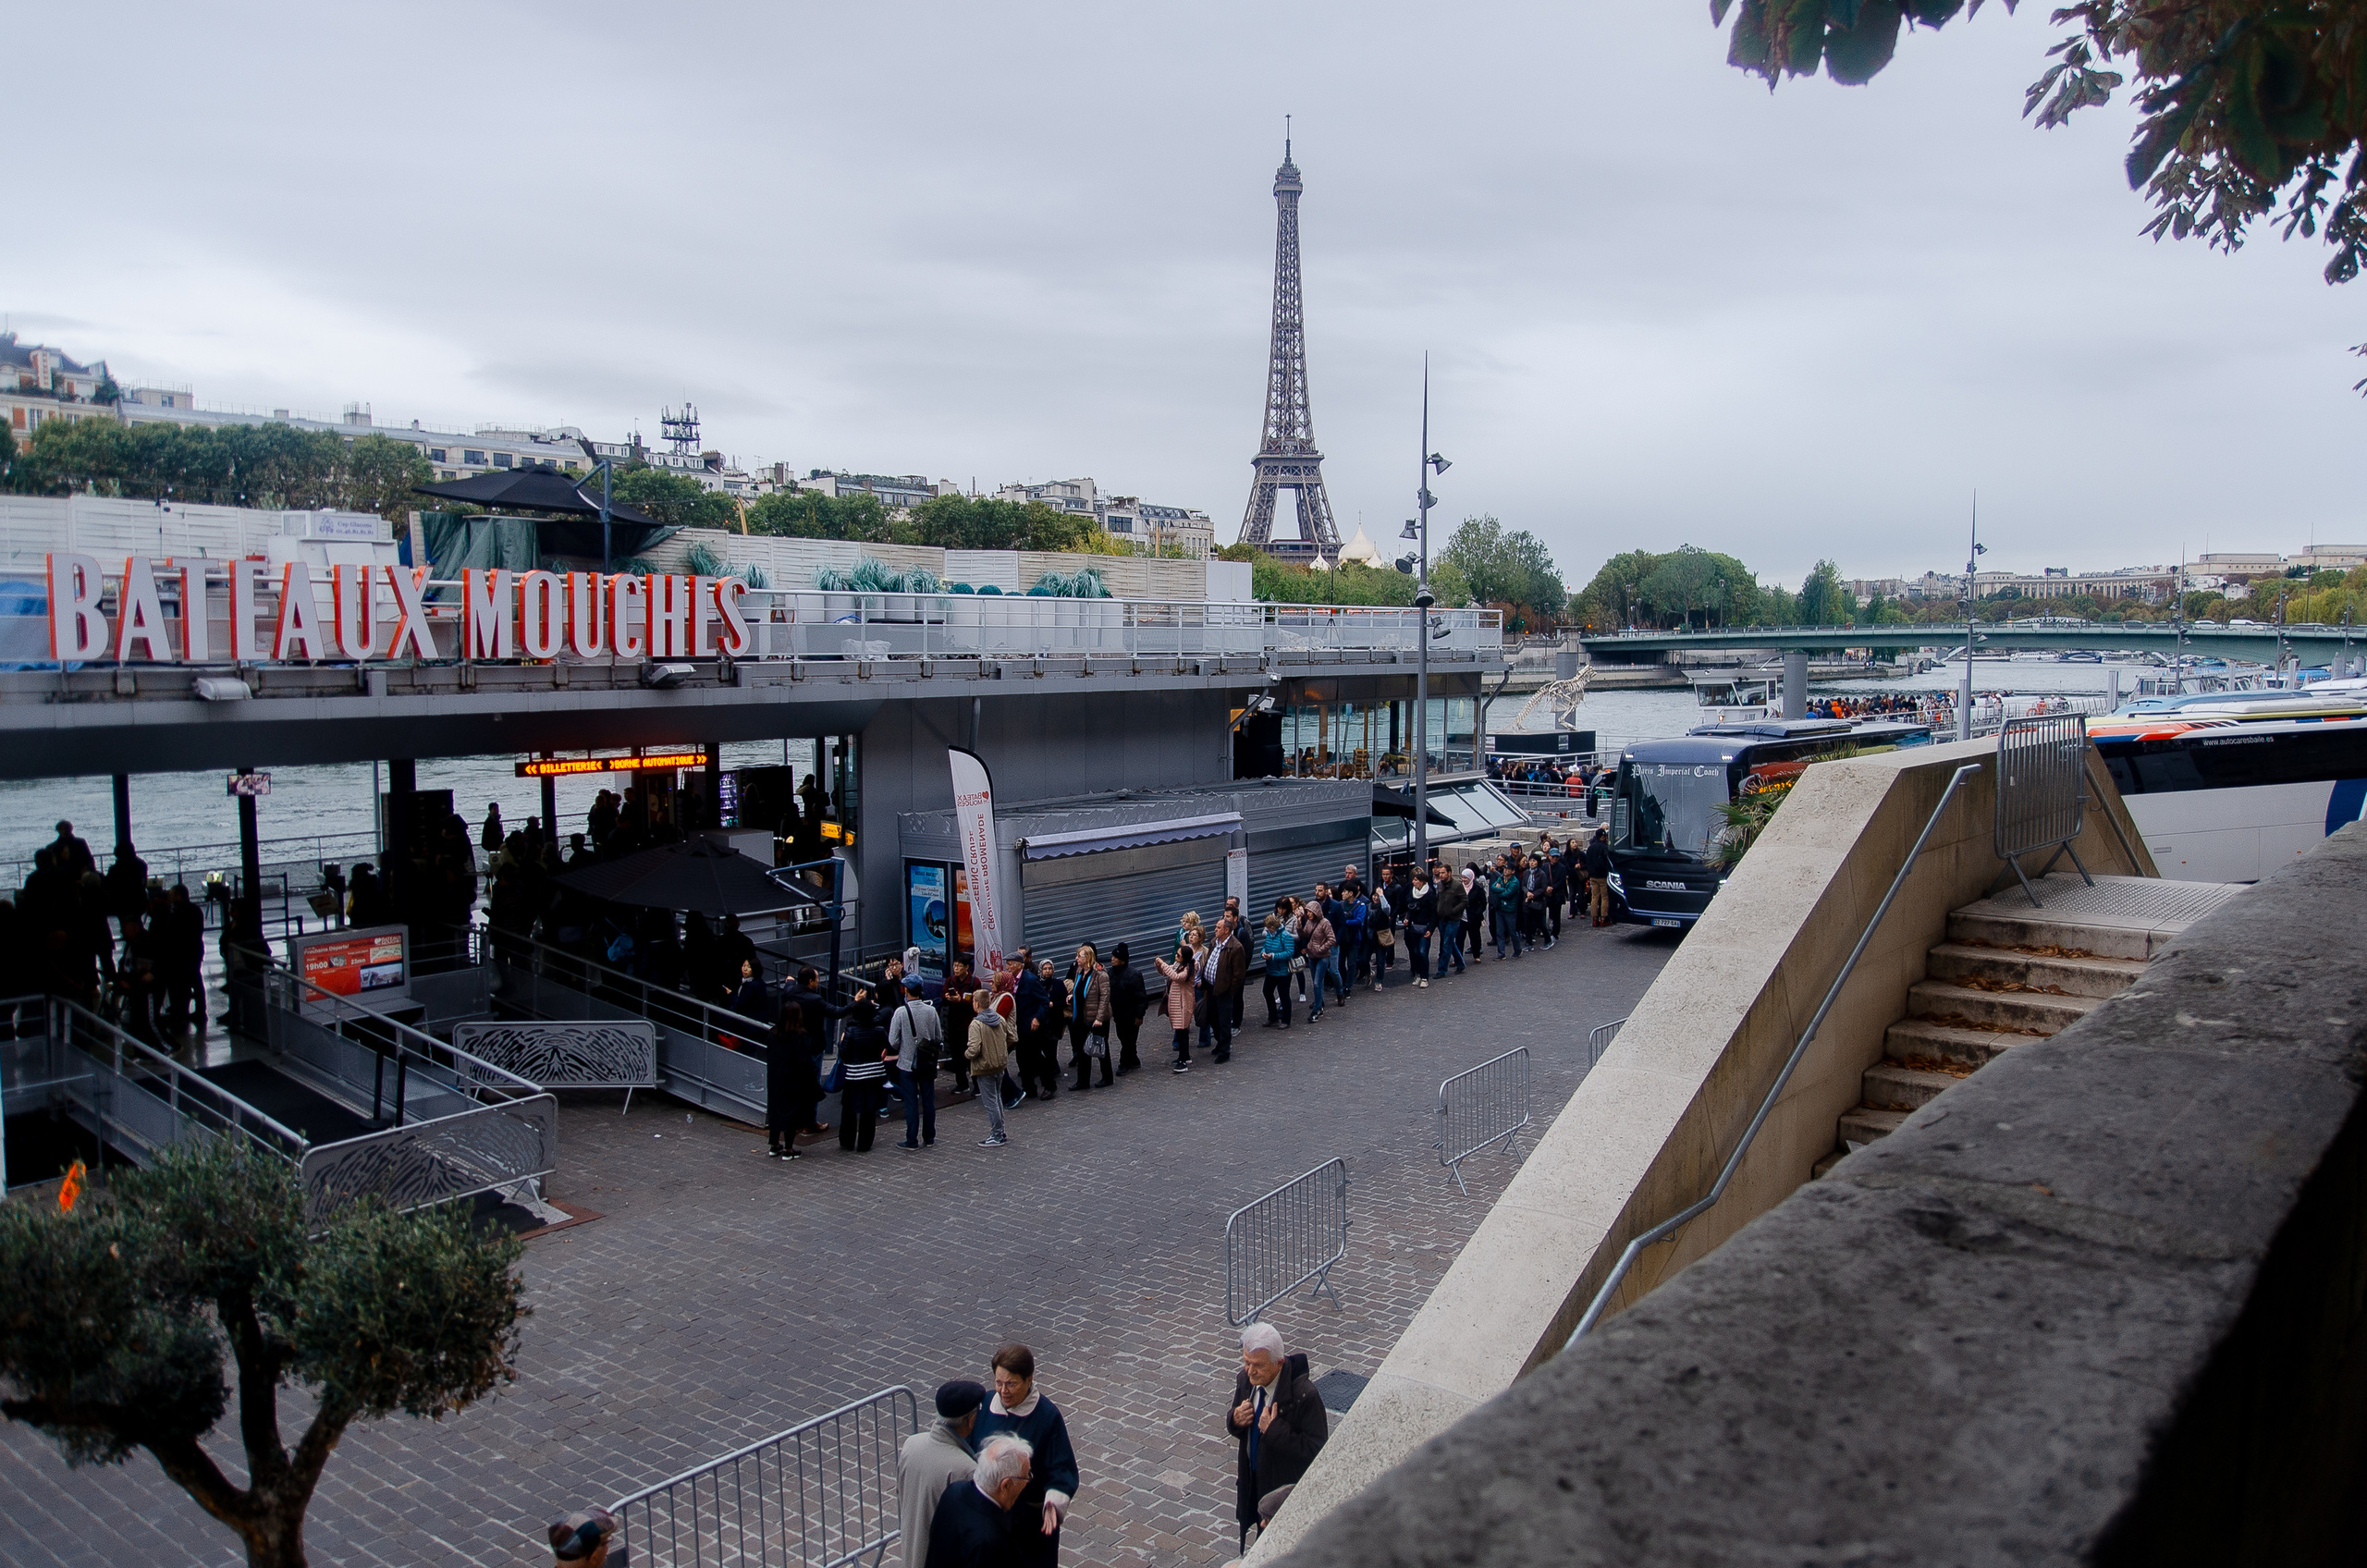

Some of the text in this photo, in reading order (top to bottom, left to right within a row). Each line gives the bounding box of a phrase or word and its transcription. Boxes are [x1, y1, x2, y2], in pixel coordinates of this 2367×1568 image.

[47, 553, 752, 661] BATEAUX MOUCHES
[2201, 736, 2275, 746] www.autocaresbaile.es
[539, 761, 596, 774] BILLETTERIE
[643, 755, 694, 767] AUTOMATIQUE
[1630, 764, 1719, 778] Paris Imperial Coach
[1646, 880, 1686, 890] SCANIA
[306, 962, 328, 972] 19h00
